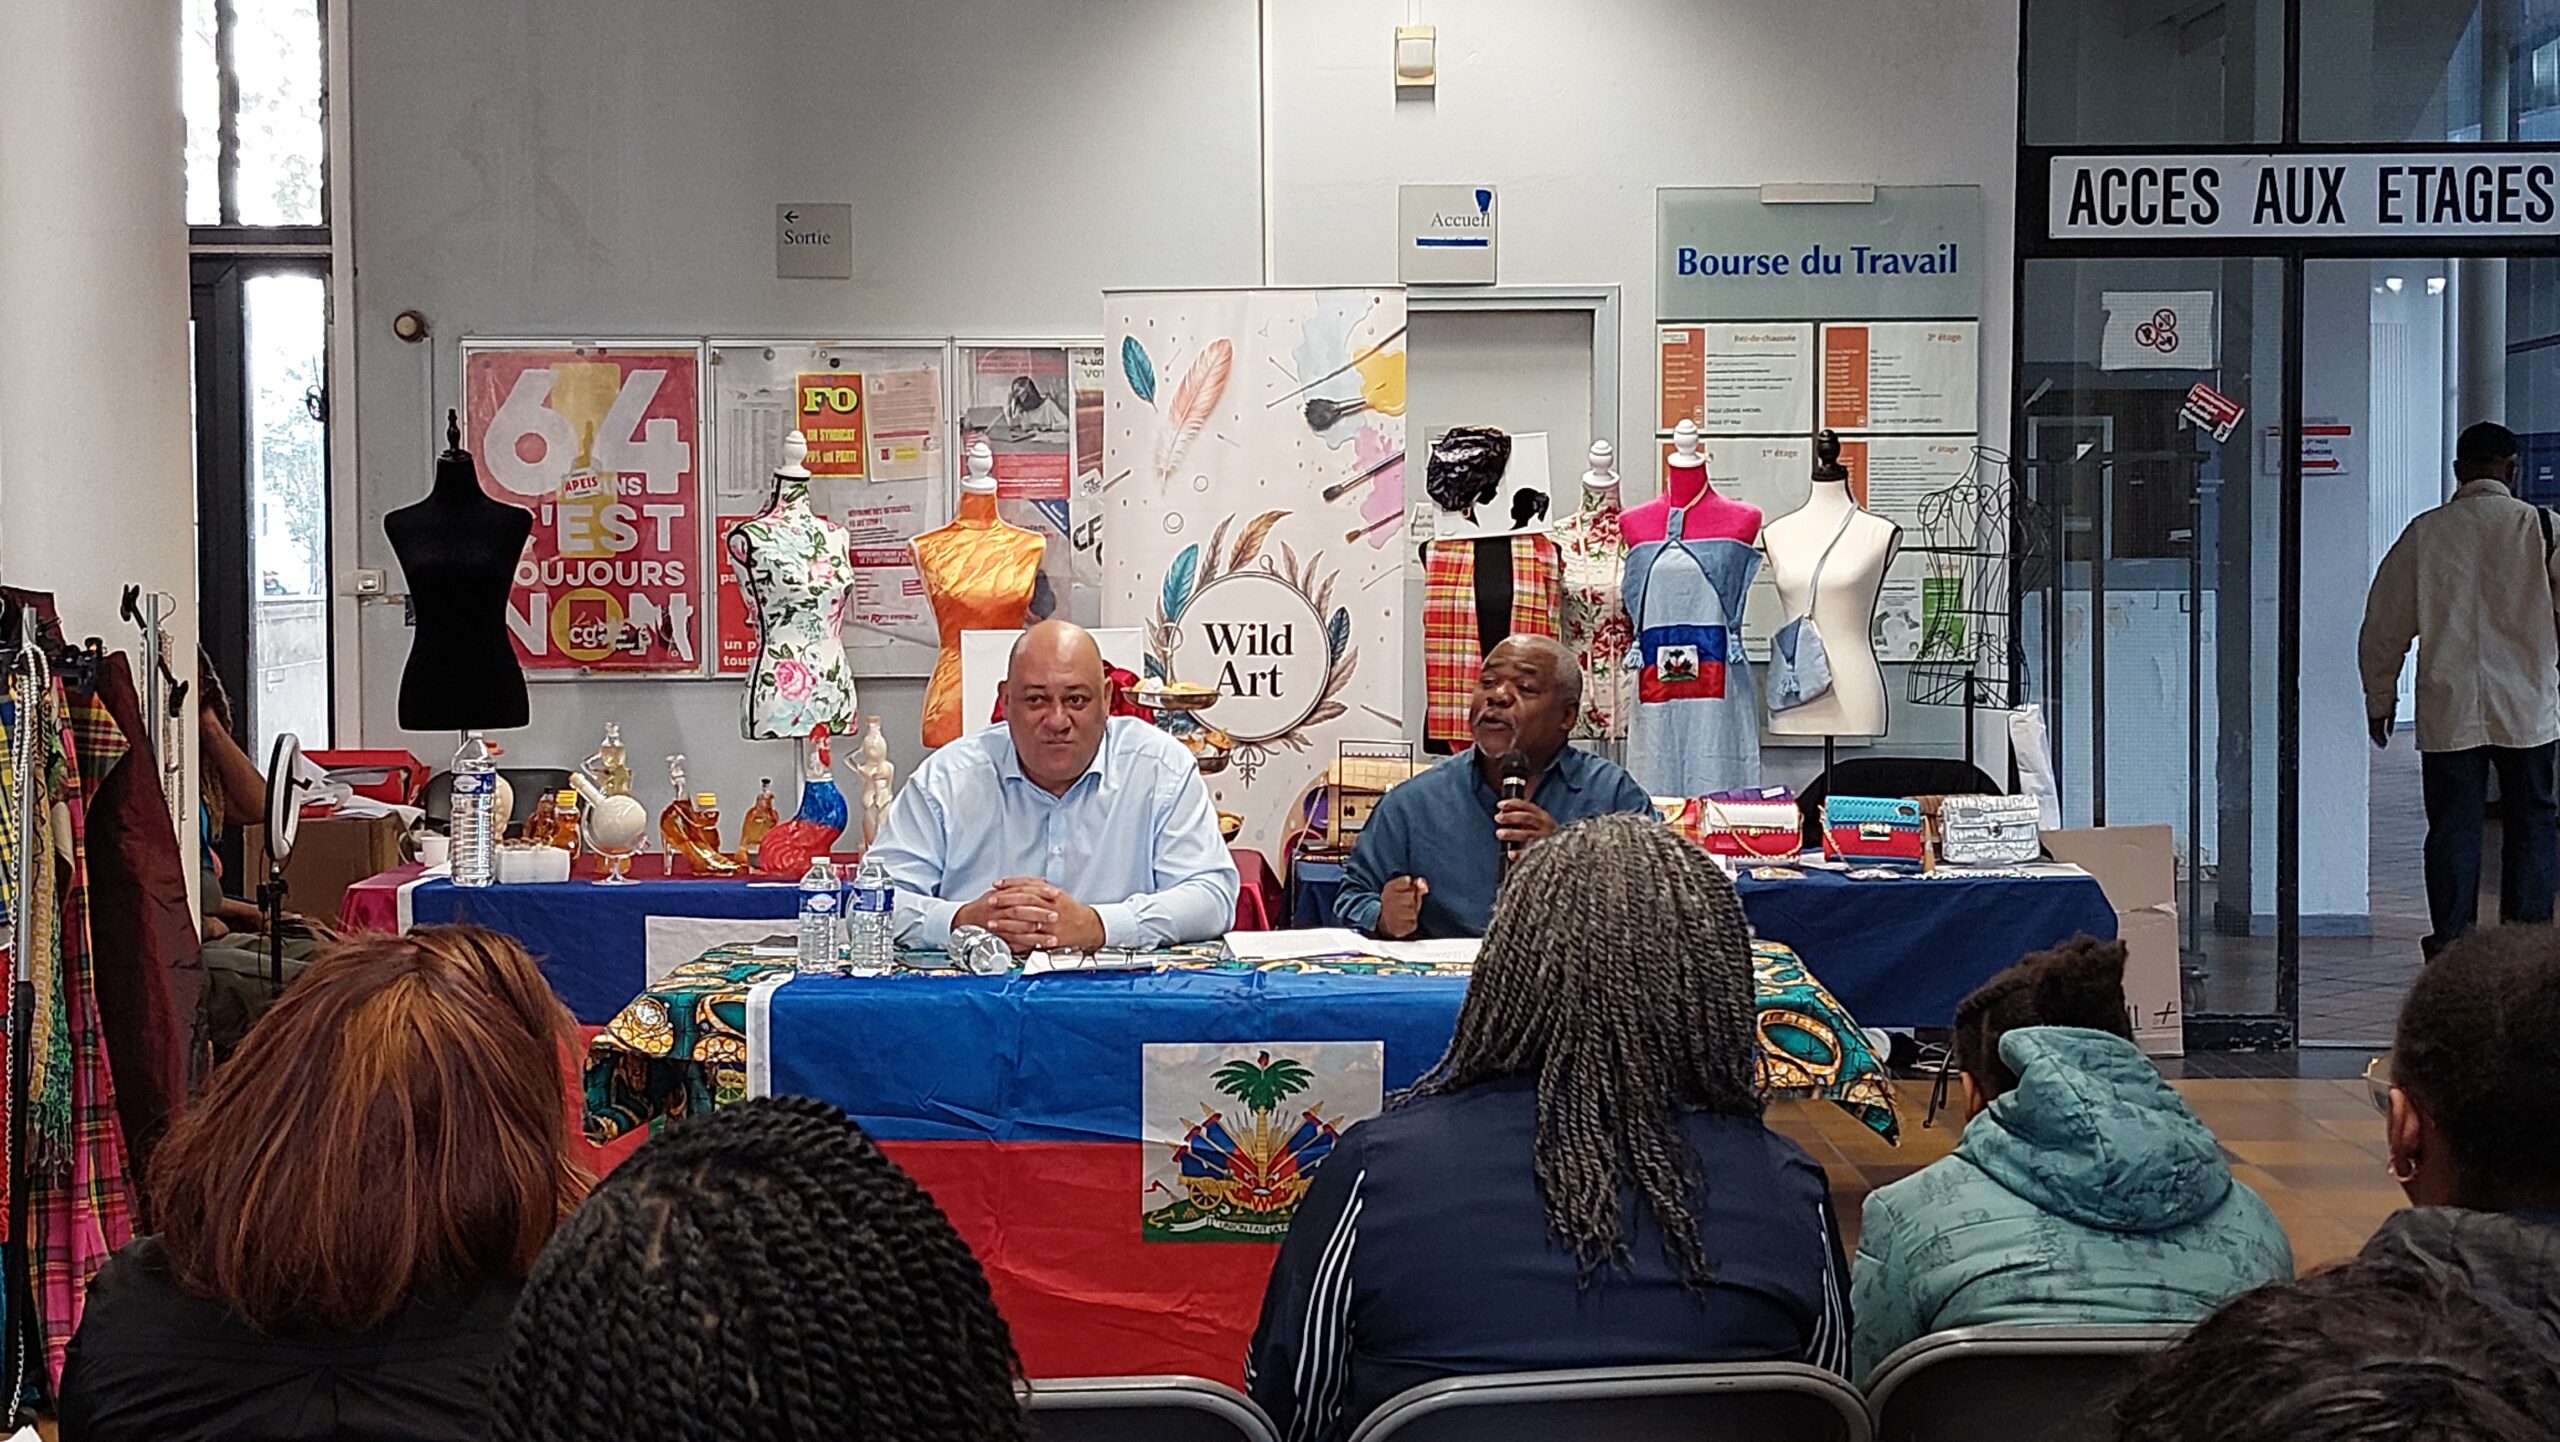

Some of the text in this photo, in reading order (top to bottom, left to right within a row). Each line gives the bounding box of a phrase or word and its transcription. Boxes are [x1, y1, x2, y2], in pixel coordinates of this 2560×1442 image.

[2067, 164, 2555, 227] ACCES AUX ETAGES
[784, 229, 831, 245] Sortie
[1678, 243, 1957, 276] Bourse du Travail
[802, 386, 858, 414] FO
[484, 369, 690, 496] 64
[514, 560, 686, 587] OUJOURS
[724, 640, 743, 650] un
[1202, 622, 1294, 656] Wild
[1216, 660, 1284, 698] Art
